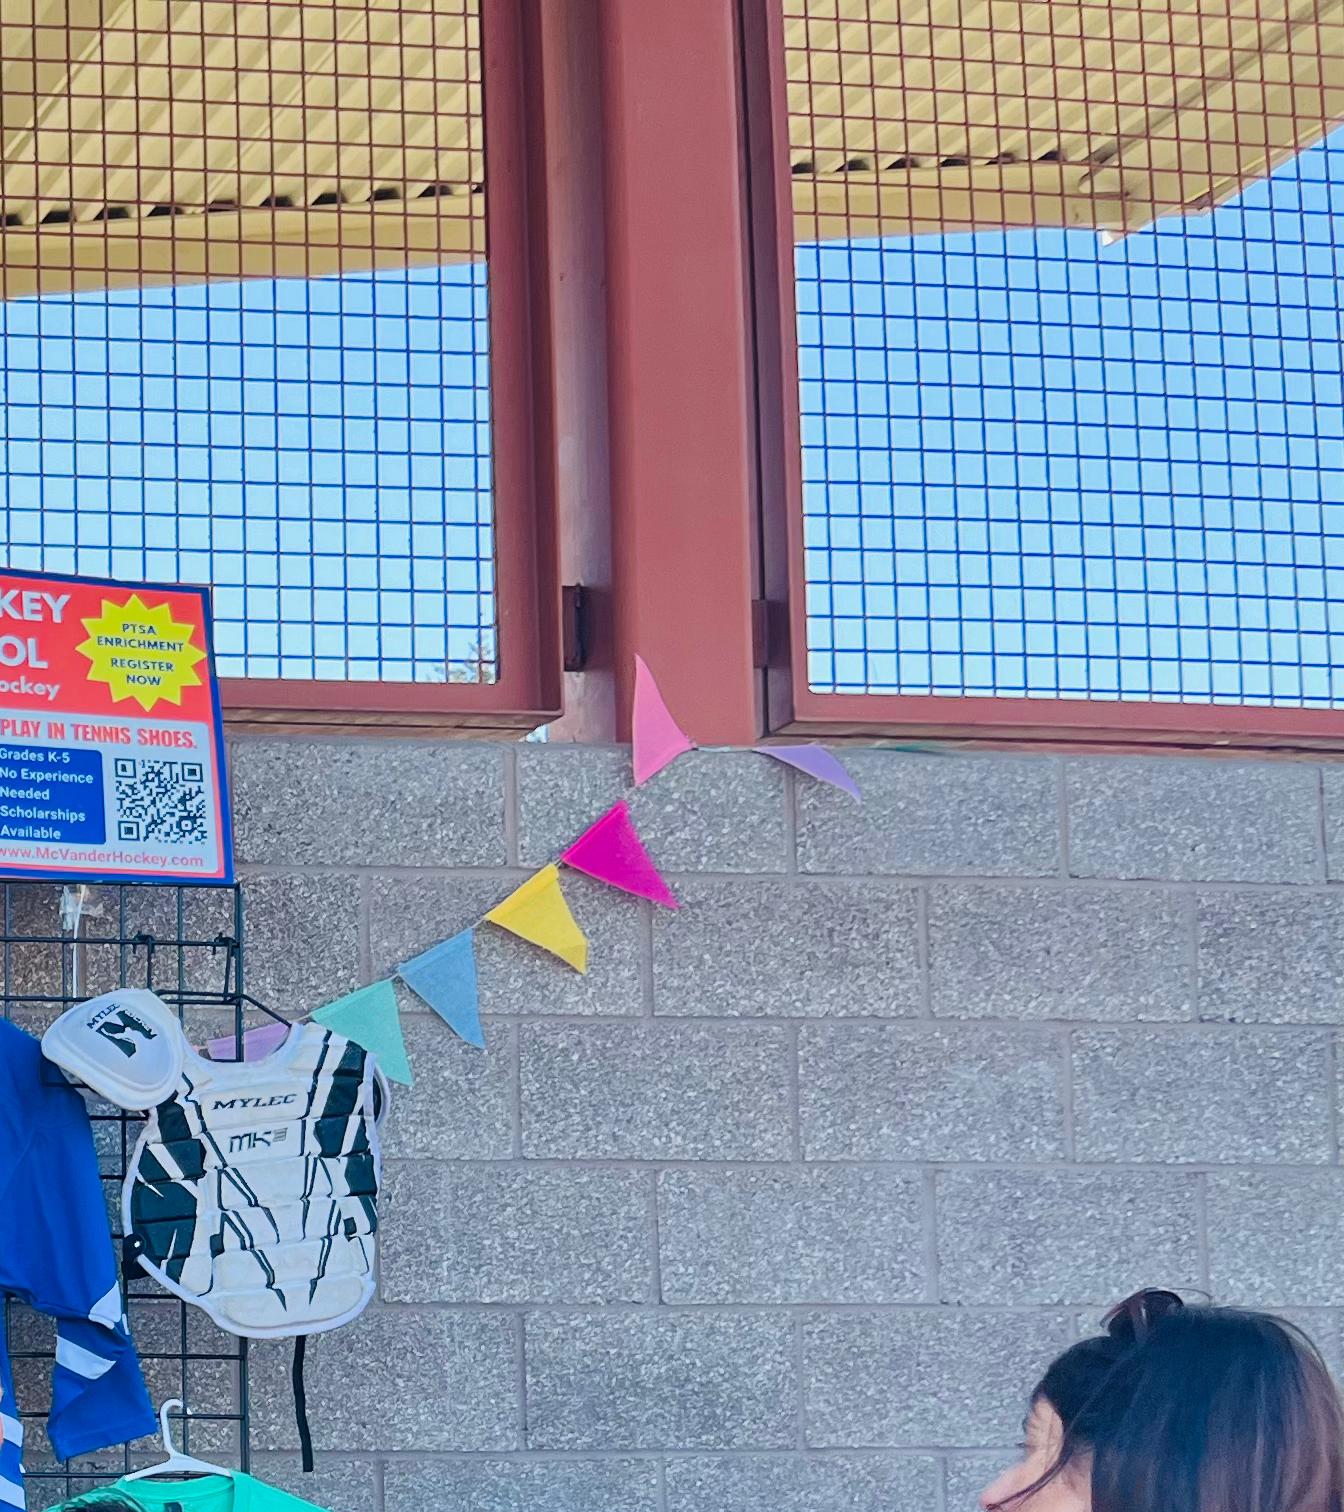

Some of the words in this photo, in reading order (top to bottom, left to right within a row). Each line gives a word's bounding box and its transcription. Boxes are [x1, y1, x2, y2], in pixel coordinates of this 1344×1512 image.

[122, 623, 157, 635] PTSA
[97, 636, 184, 652] ENRICHMENT
[111, 658, 174, 672] REGISTER
[127, 675, 161, 686] NOW
[0, 718, 40, 738] PLAY
[47, 721, 65, 740] IN
[71, 723, 131, 744] TENNIS
[137, 728, 197, 749] SHOES.
[48, 751, 70, 763] K-5
[0, 767, 17, 779] No
[21, 768, 93, 783] Experience
[0, 786, 50, 800] Needed
[0, 805, 86, 823] Scholarships
[0, 825, 61, 839] Available
[211, 1094, 297, 1110] MYLEC
